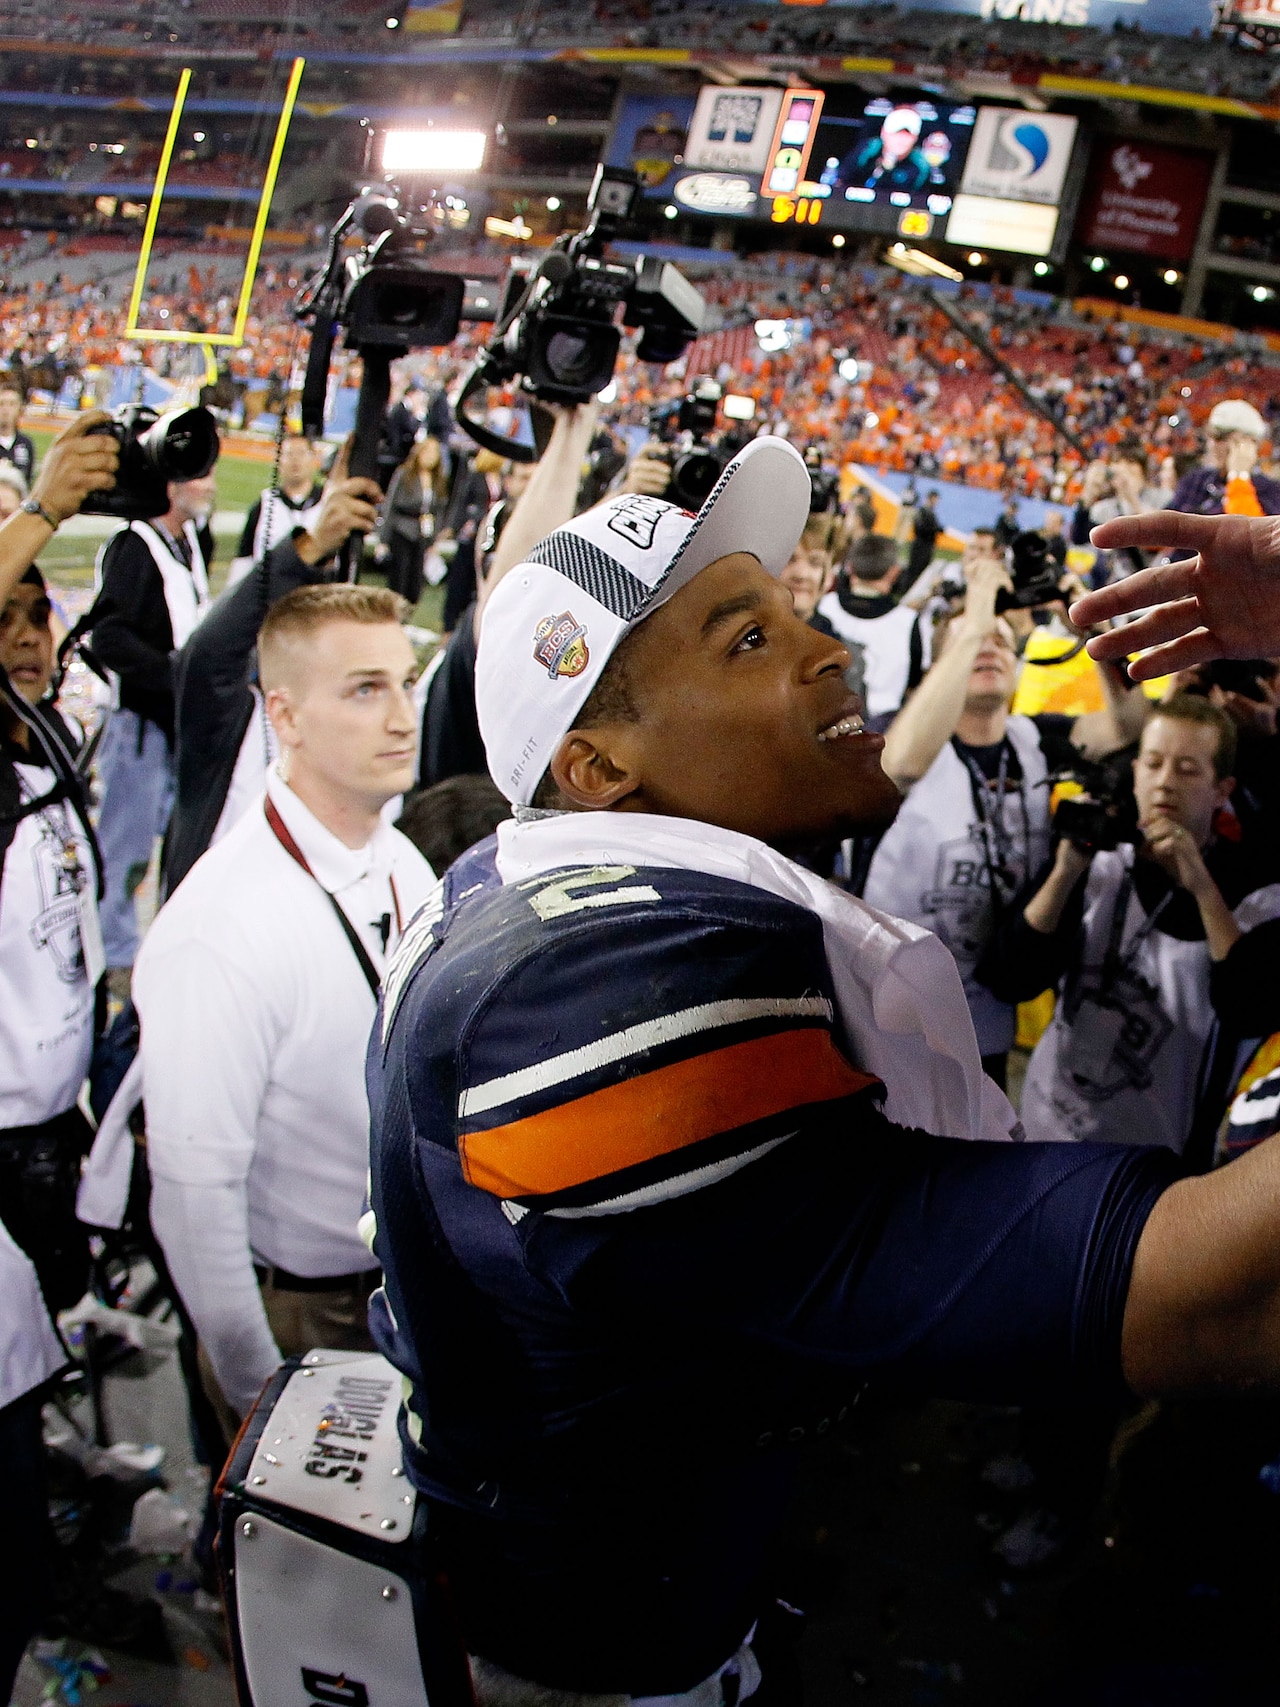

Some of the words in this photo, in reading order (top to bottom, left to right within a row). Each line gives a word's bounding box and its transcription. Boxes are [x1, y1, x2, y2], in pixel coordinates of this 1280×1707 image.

[540, 620, 575, 662] BCS
[511, 736, 538, 787] DRI-FIT
[304, 1376, 395, 1483] DOUGLAS
